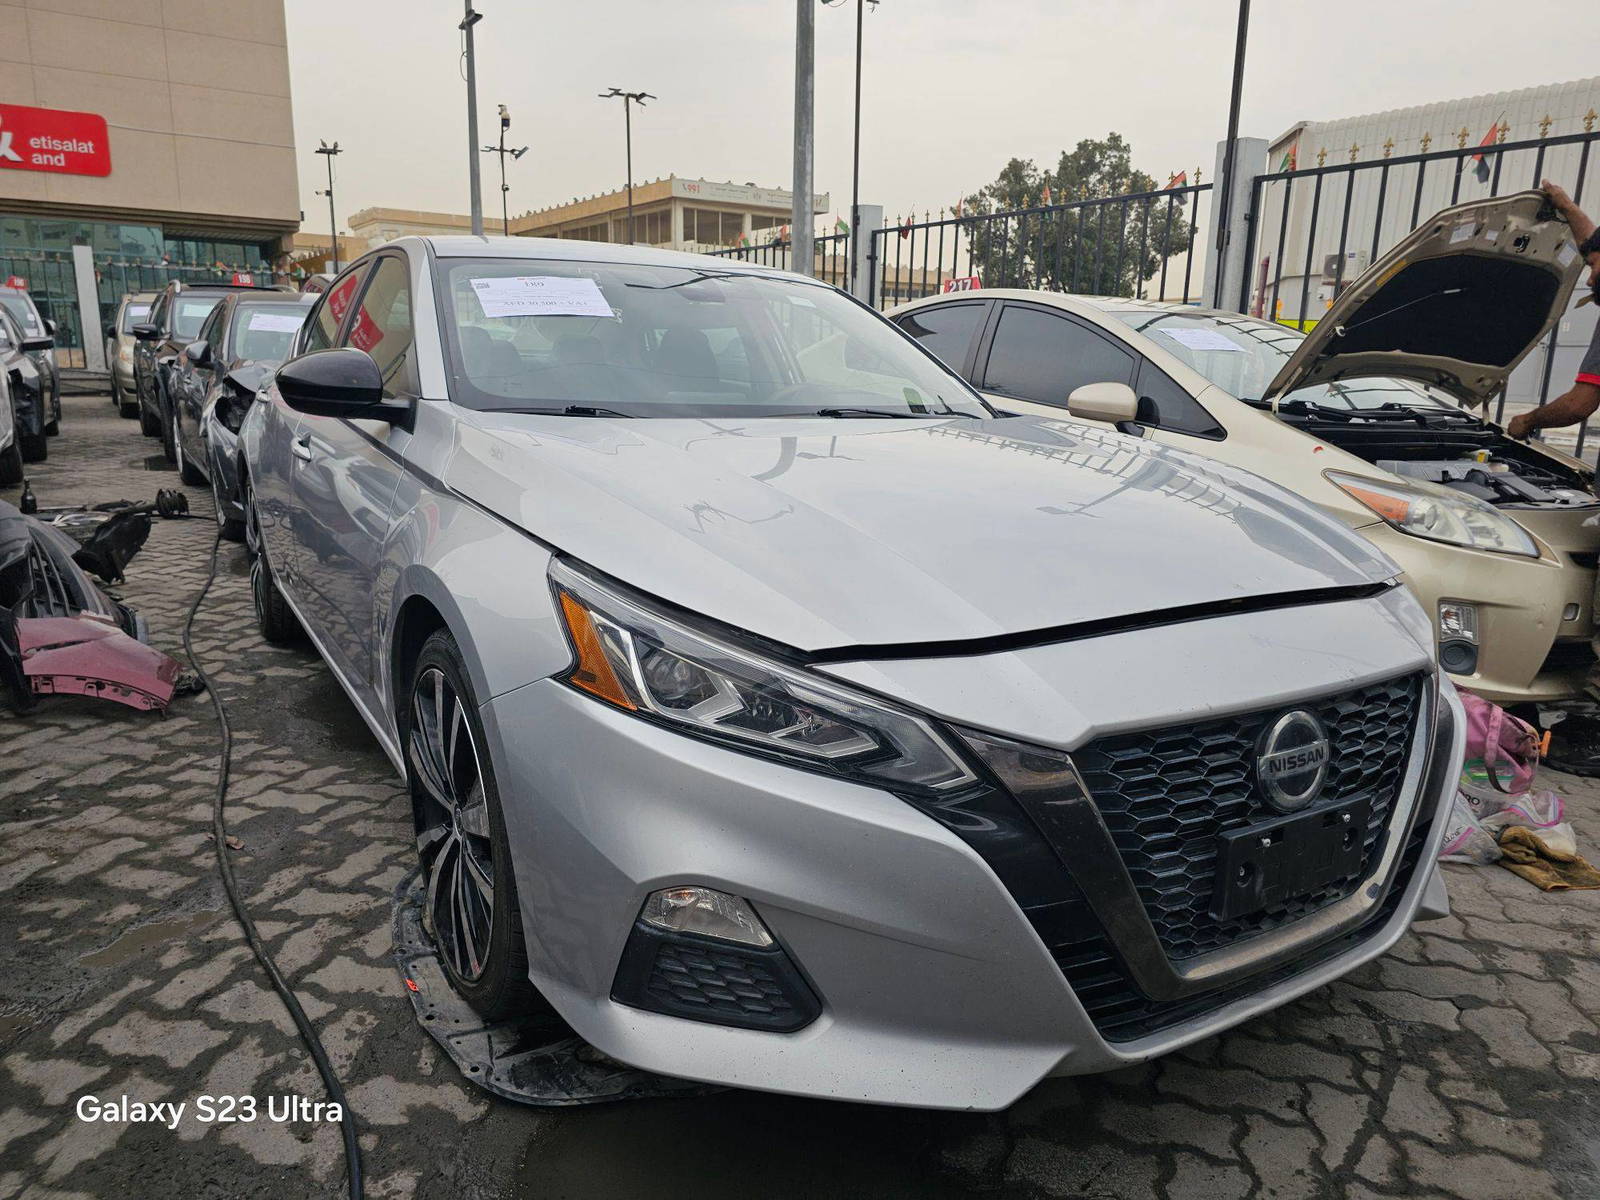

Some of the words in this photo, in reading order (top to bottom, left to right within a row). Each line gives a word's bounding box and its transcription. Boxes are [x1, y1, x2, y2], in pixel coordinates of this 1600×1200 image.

[30, 136, 95, 154] etisalat
[32, 153, 65, 166] and
[950, 279, 972, 293] 217
[1269, 746, 1324, 773] NISSAN
